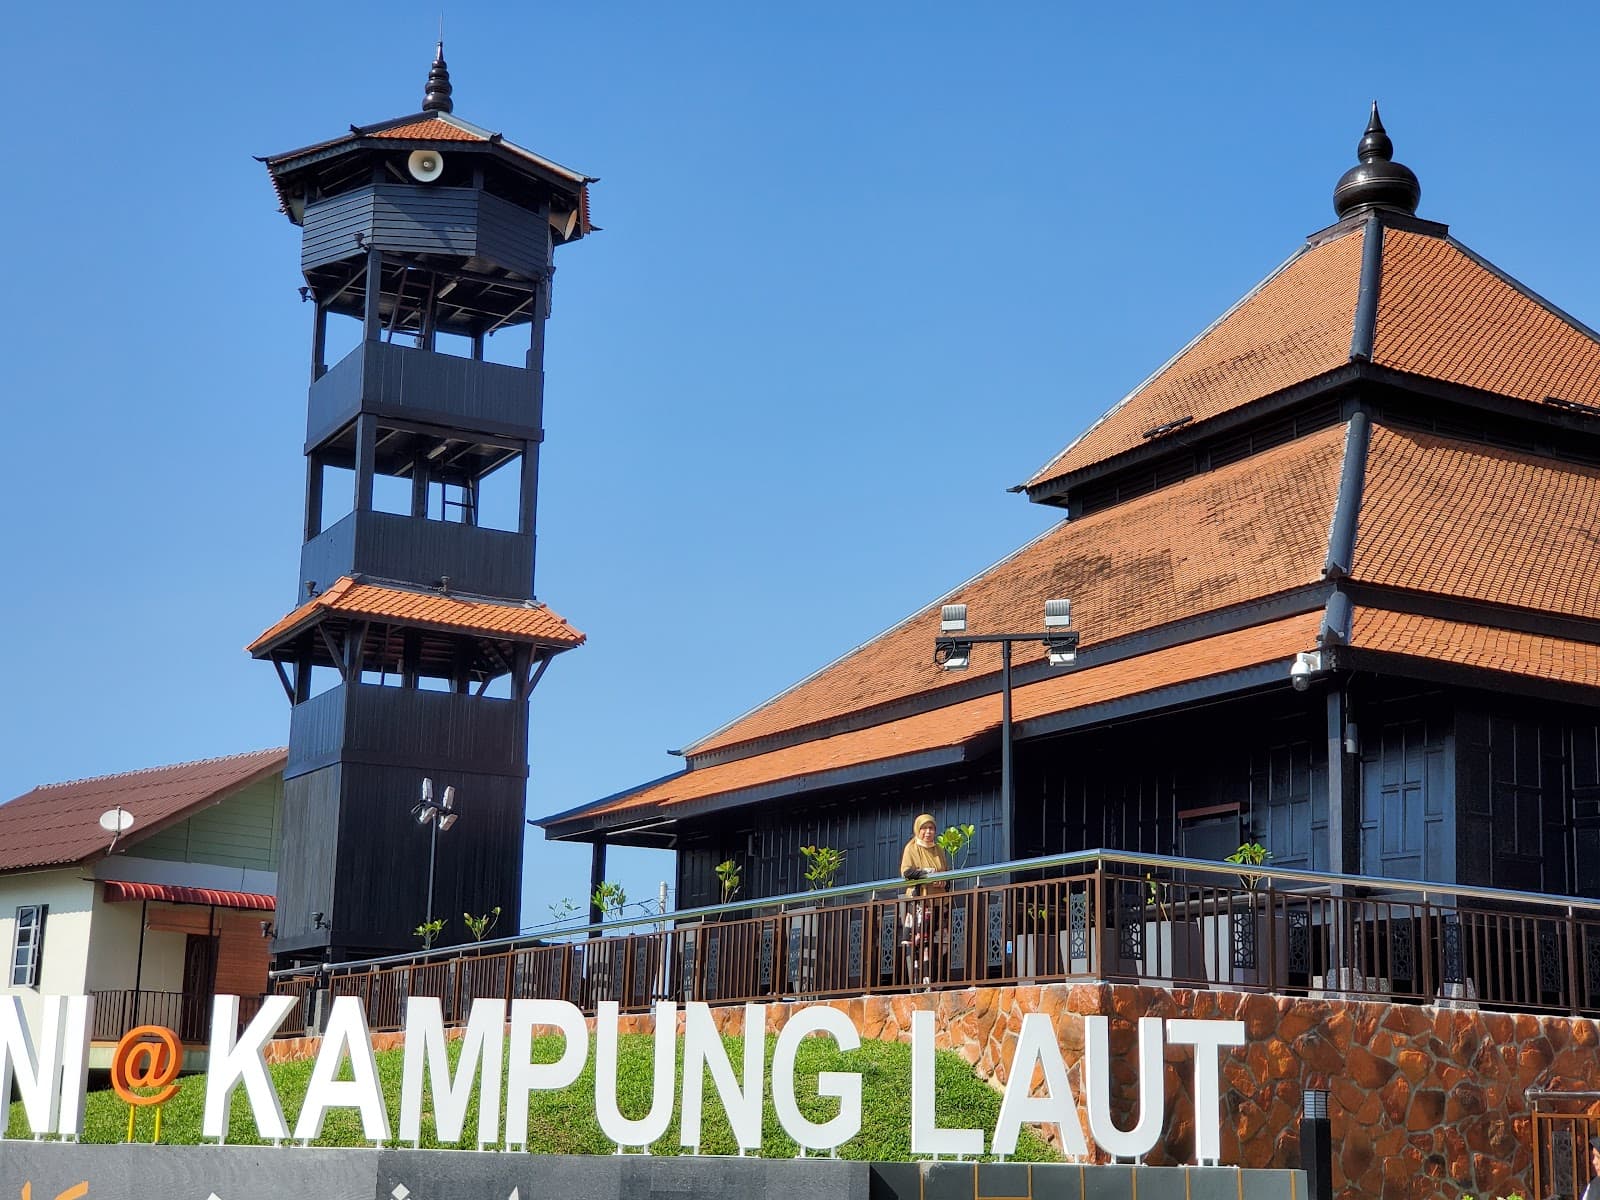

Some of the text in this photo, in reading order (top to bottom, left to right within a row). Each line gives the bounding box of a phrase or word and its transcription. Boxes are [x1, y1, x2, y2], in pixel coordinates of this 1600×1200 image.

[111, 1025, 183, 1105] @
[203, 995, 862, 1149] KAMPUNG
[911, 1010, 1246, 1161] LAUT
